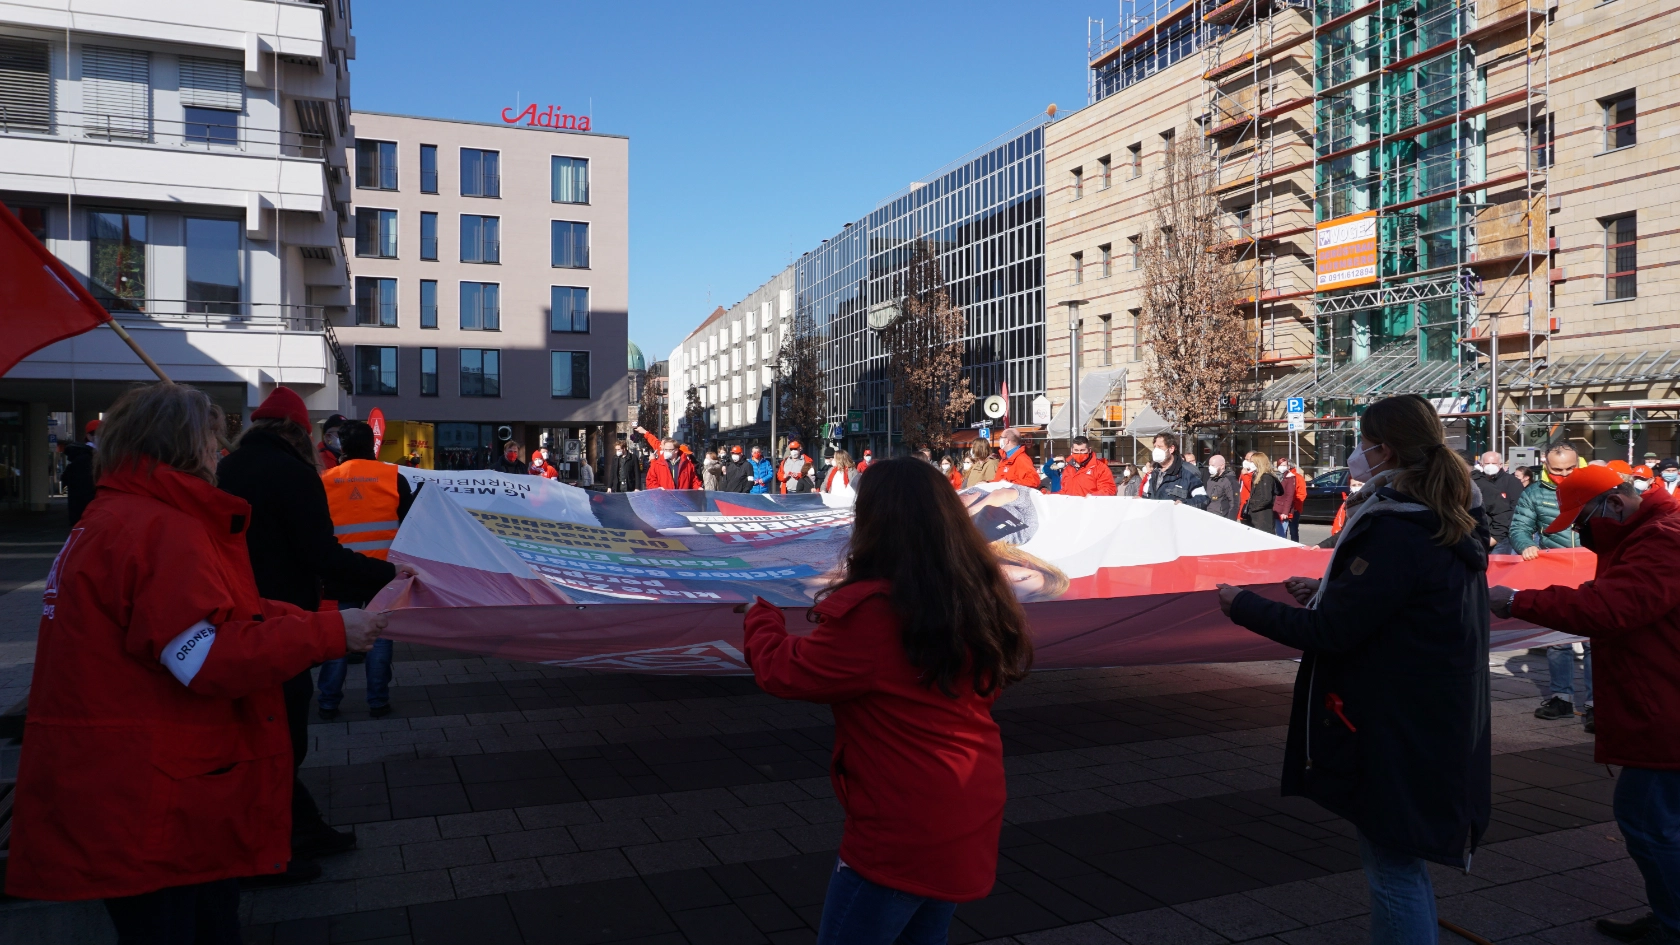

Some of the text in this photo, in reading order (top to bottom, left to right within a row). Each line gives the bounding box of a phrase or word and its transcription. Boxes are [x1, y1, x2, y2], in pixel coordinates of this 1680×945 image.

[501, 103, 592, 131] Adina
[1331, 220, 1374, 243] VOGEL
[1318, 253, 1375, 273] NÜRNBERG
[1289, 399, 1299, 412] P
[504, 489, 526, 499] IG
[495, 522, 670, 549] Übernahme
[618, 556, 729, 567] stabile
[676, 568, 796, 580] sichere
[621, 585, 721, 599] klare
